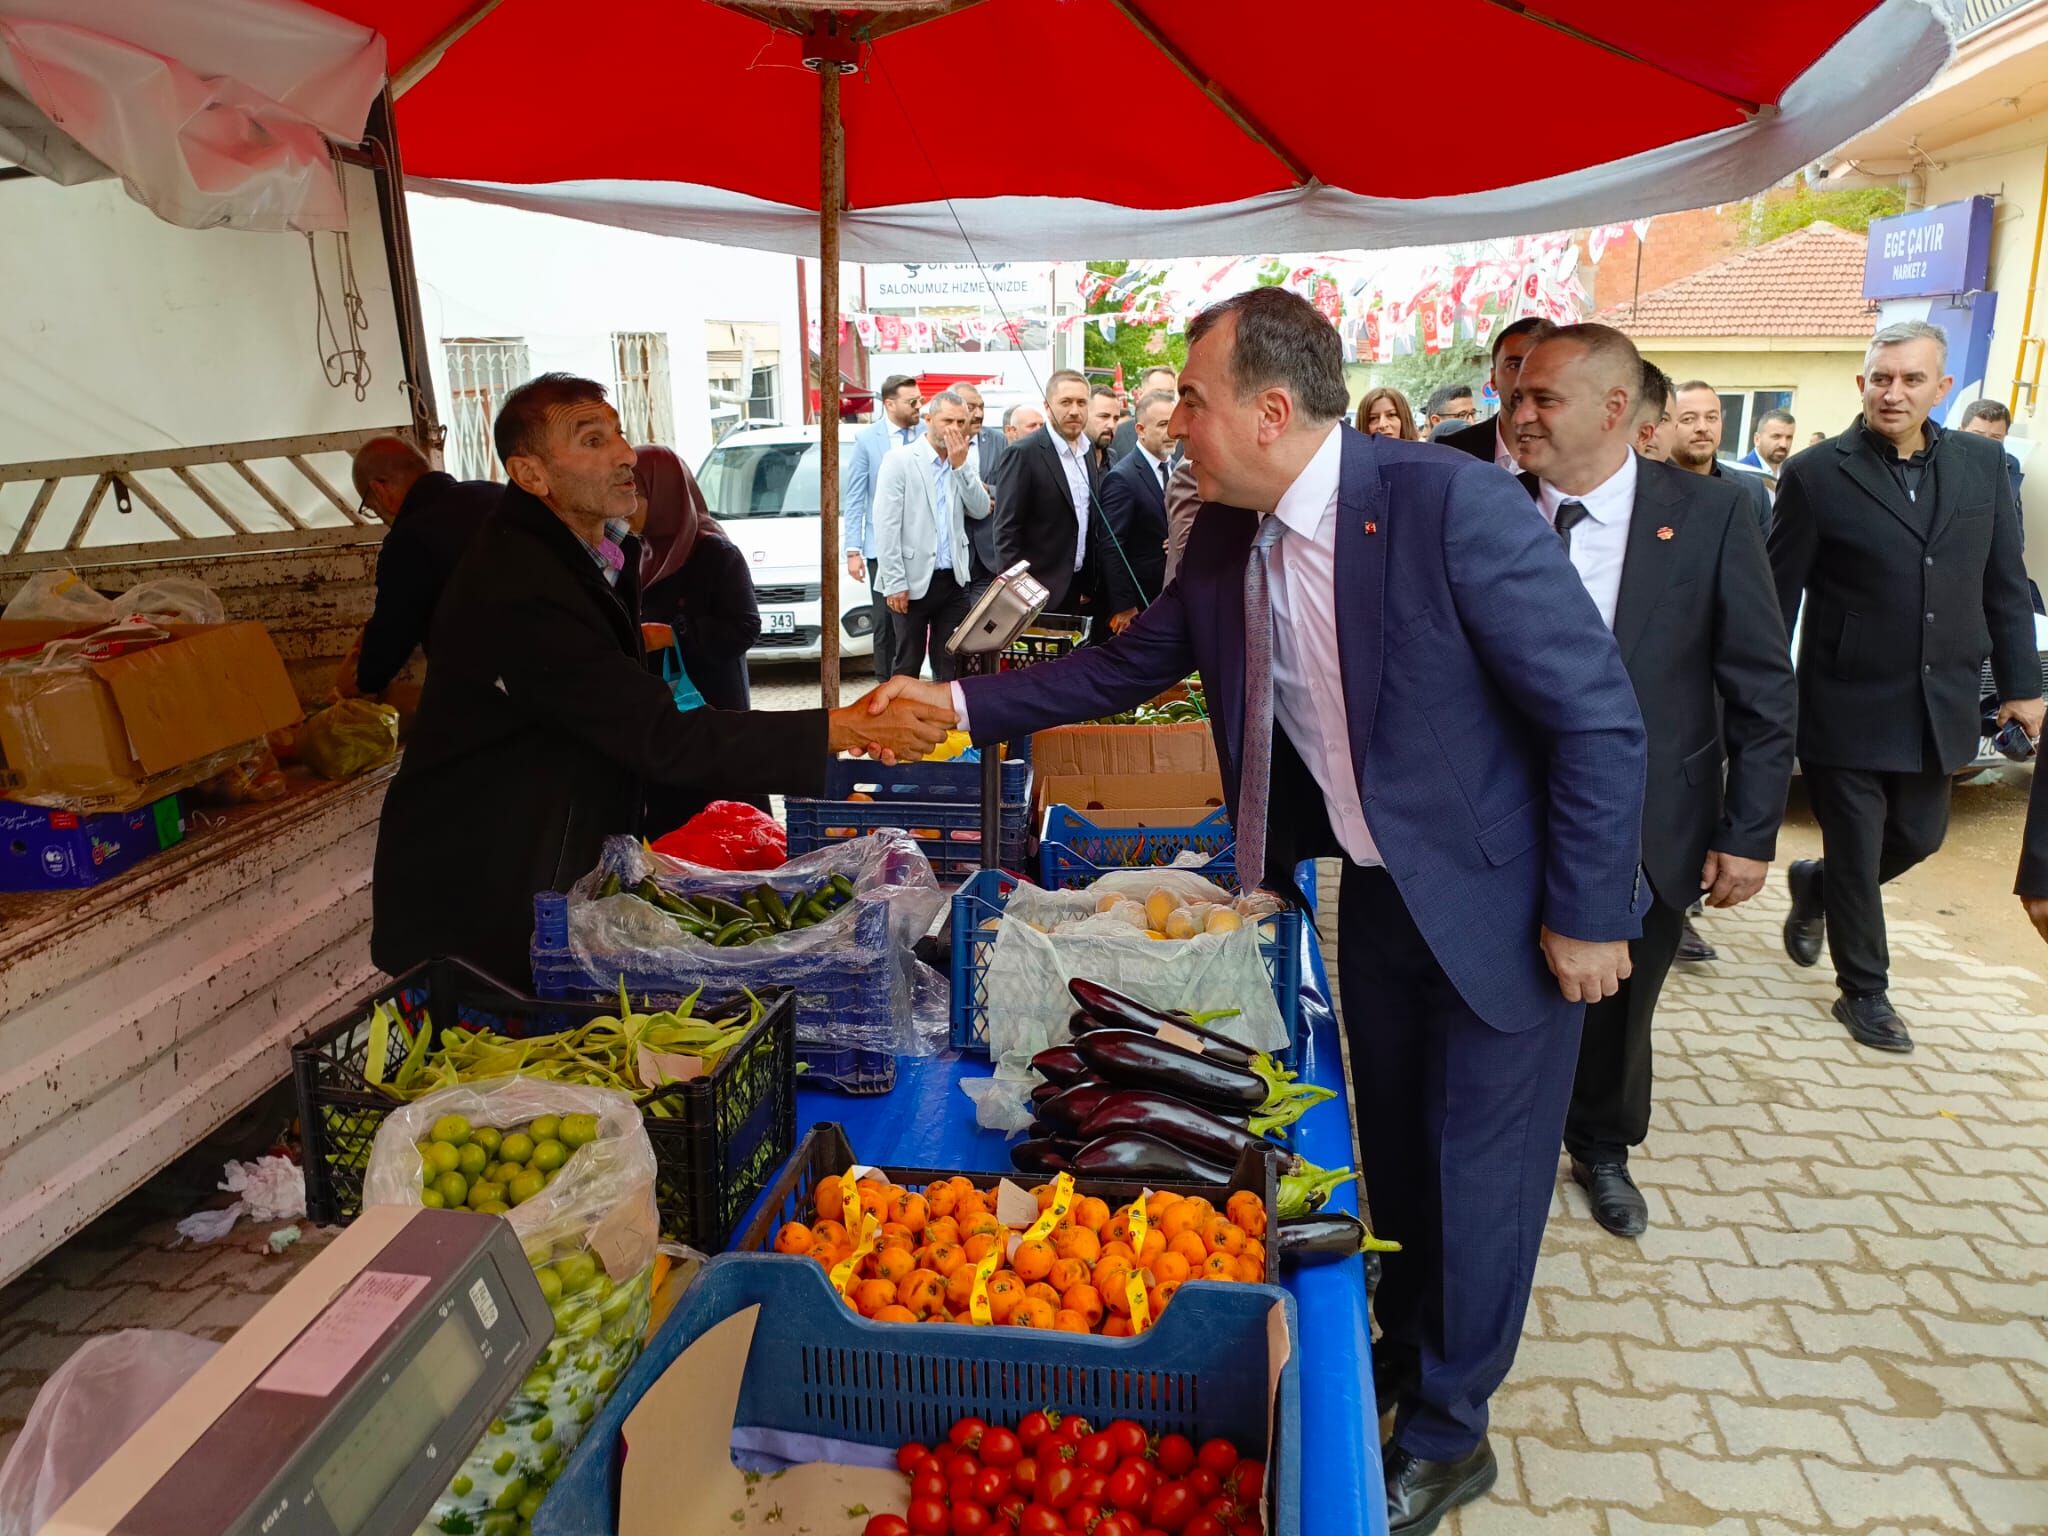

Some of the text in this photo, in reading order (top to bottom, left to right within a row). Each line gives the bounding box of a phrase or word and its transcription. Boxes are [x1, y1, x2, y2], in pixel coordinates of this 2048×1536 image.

[1884, 222, 1945, 262] EGE ÇAYIR
[1892, 260, 1927, 280] MARKET 2
[879, 281, 949, 295] SALONUMUZ
[770, 614, 792, 628] 343
